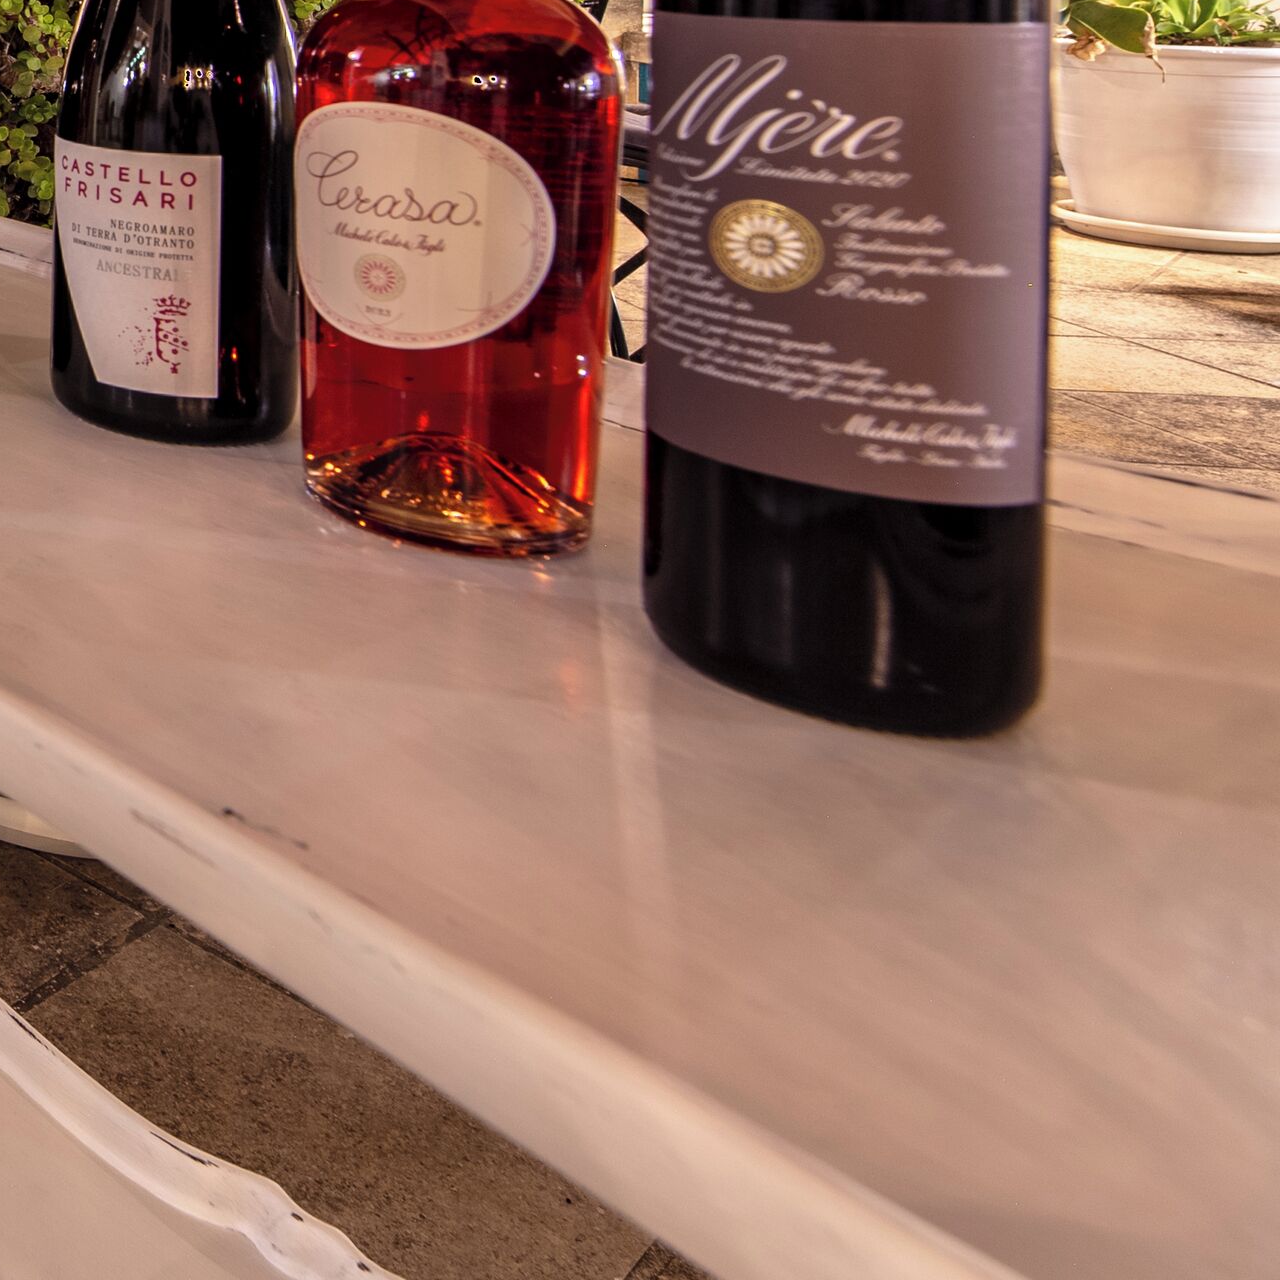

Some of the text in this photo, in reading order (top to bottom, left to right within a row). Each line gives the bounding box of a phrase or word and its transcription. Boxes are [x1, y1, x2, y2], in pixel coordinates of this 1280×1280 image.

[61, 155, 197, 188] CASTELLO
[64, 176, 194, 210] FRISARI
[71, 222, 195, 249] DI TERRA D'OTRANTO
[110, 219, 195, 237] NEGROAMARO
[72, 237, 194, 262] DENOMINAZIONE DI ORIGINE PROTETTA
[815, 272, 928, 306] Rosso
